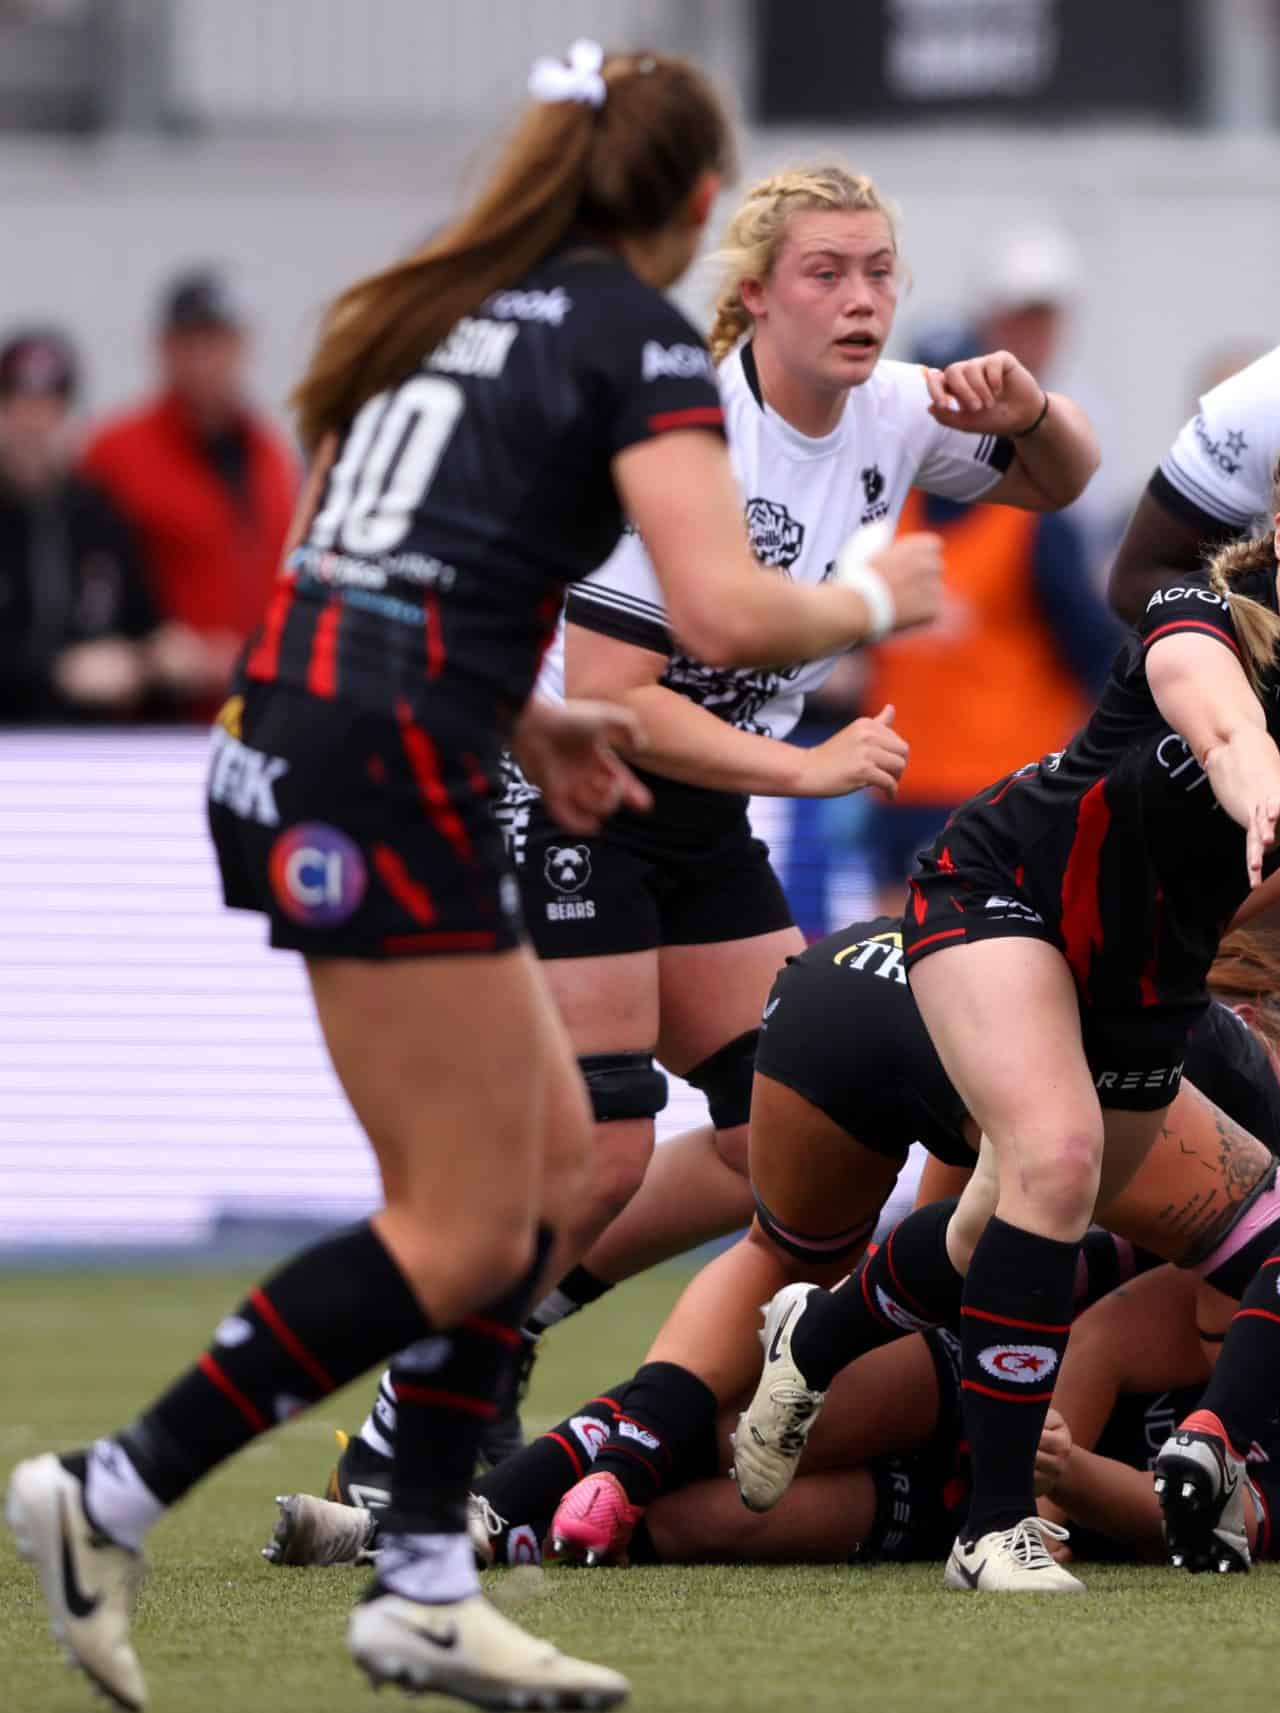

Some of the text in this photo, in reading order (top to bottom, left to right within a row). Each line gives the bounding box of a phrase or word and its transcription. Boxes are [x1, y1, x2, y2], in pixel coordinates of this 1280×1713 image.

[308, 373, 466, 556] 10
[284, 847, 342, 907] CI
[546, 900, 597, 921] BEARS
